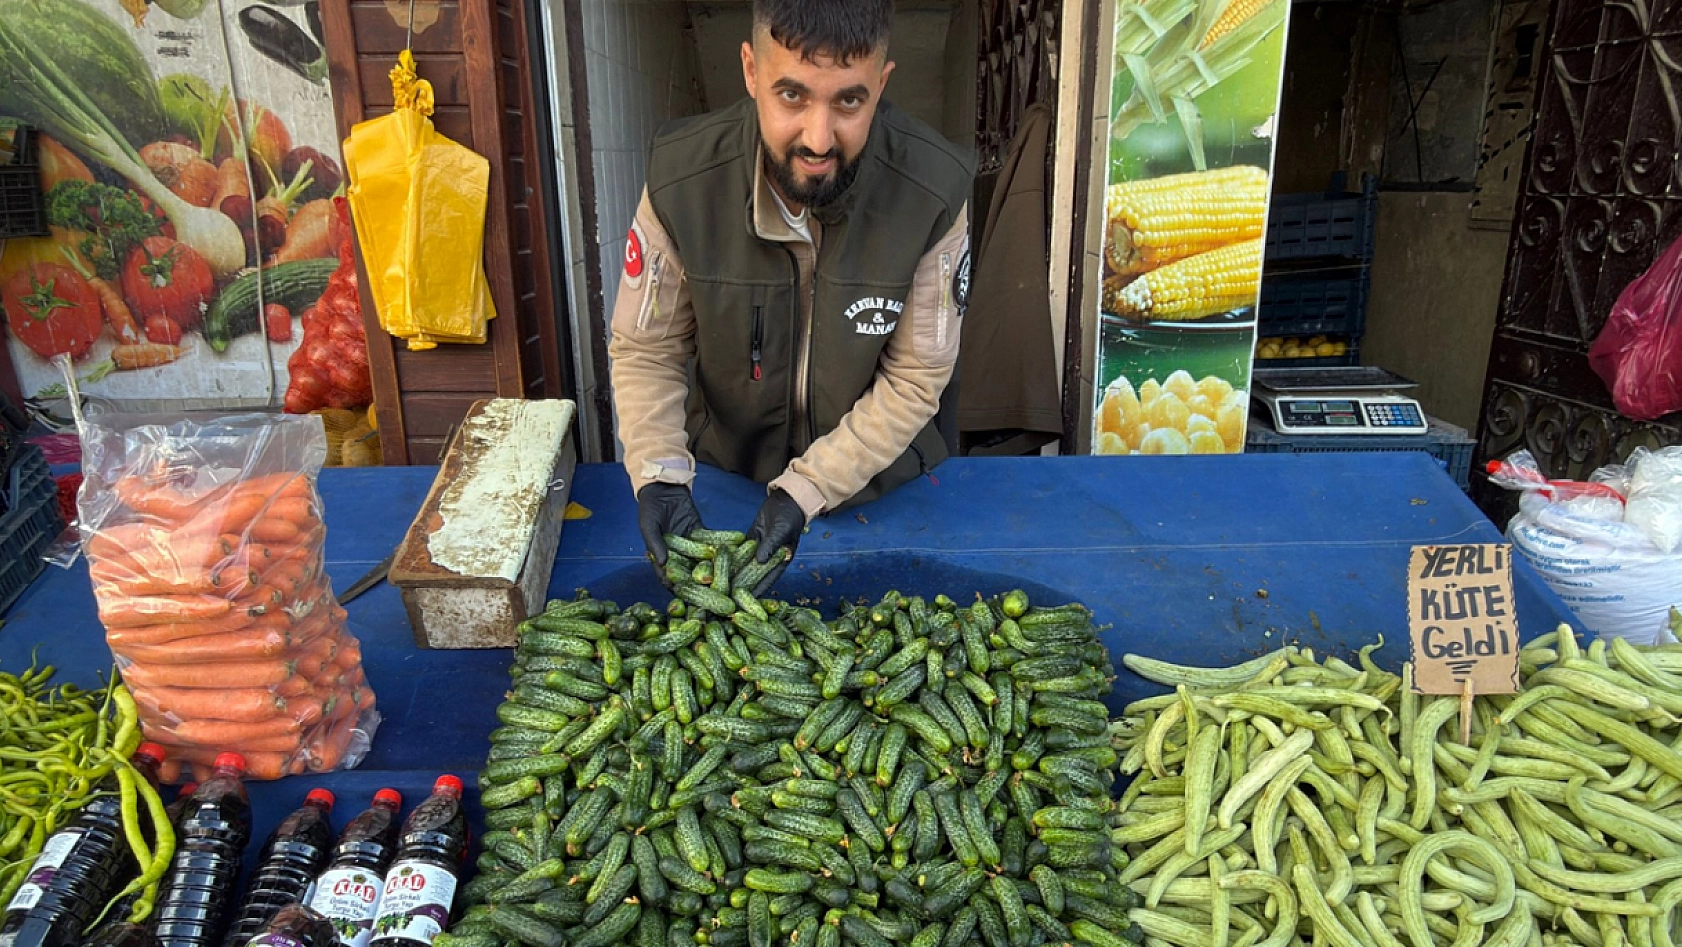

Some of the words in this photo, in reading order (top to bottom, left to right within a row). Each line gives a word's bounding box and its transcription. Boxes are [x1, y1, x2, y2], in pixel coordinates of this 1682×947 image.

[872, 312, 885, 323] &
[1420, 582, 1506, 621] KÜTE
[1422, 620, 1509, 659] Geldi
